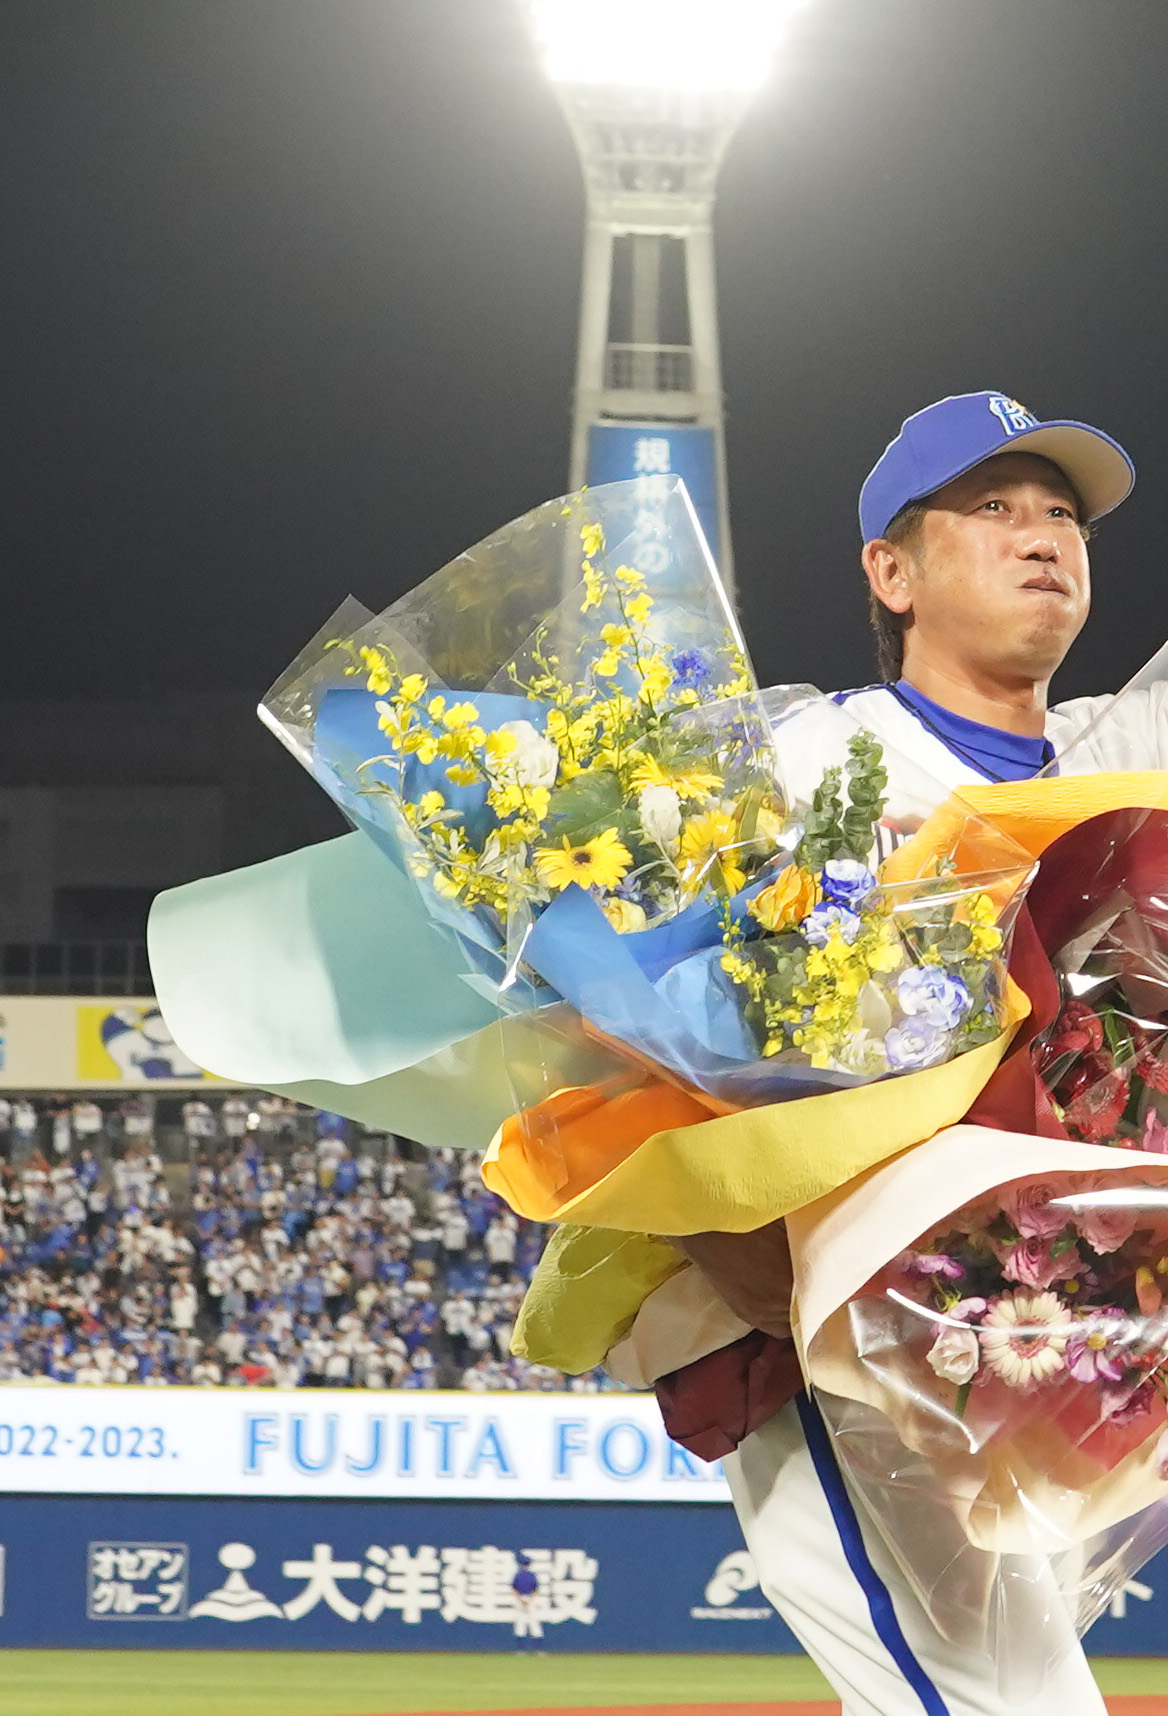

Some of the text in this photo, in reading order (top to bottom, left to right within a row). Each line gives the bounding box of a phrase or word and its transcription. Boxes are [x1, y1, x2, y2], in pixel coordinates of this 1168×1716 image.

[242, 1411, 728, 1482] FUJITA FOR
[92, 1548, 184, 1580] オセアン
[282, 1543, 599, 1625] 大洋建設
[92, 1581, 184, 1614] グループ
